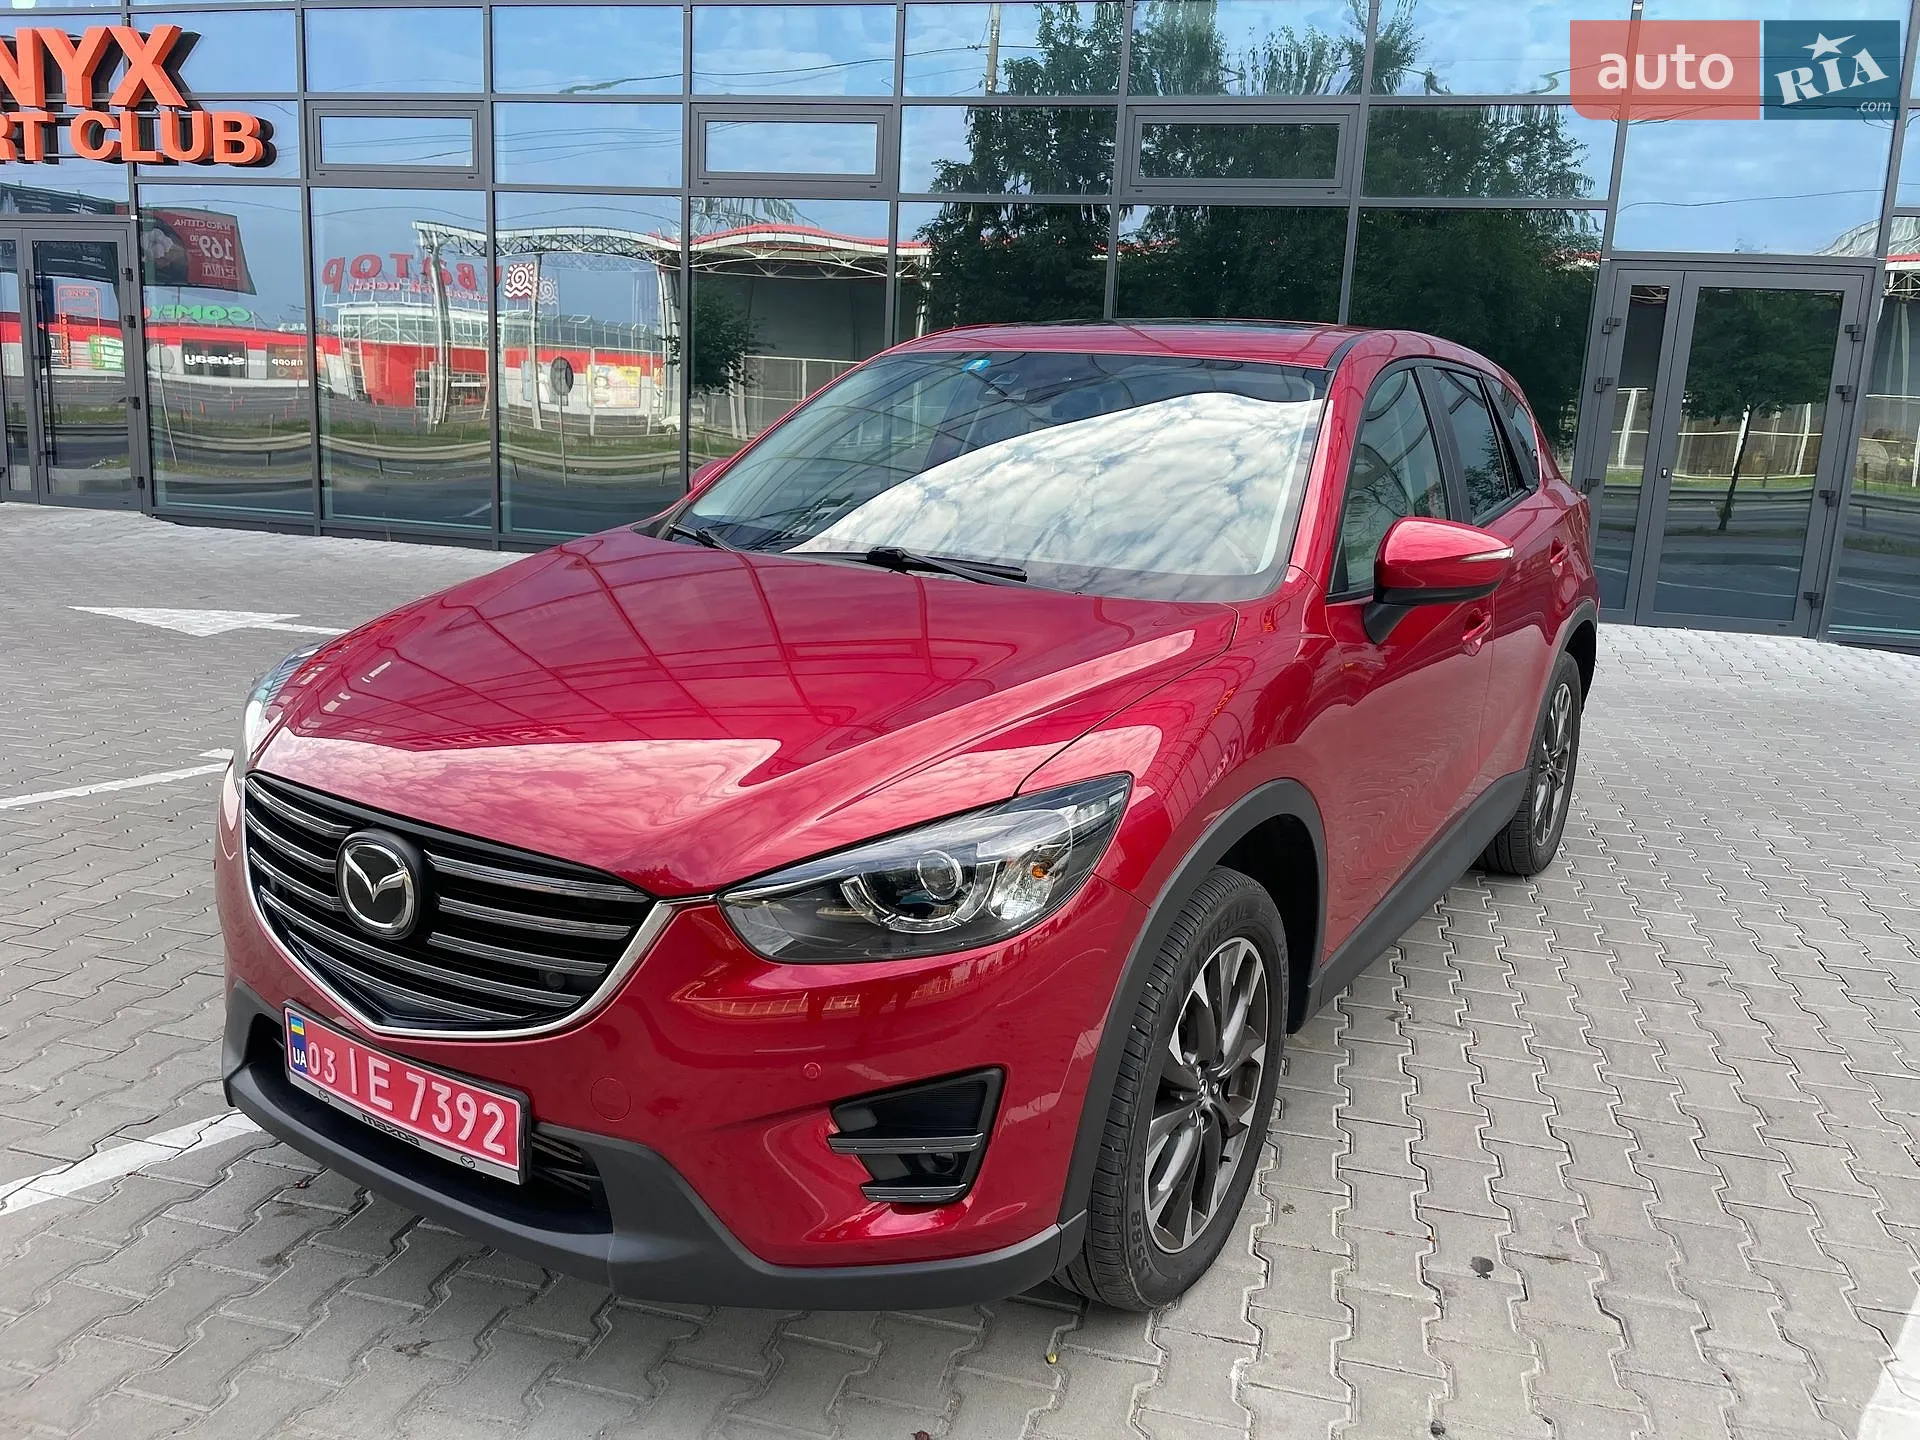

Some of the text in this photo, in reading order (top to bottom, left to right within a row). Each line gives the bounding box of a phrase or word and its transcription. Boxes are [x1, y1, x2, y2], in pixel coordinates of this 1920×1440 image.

[70, 110, 264, 164] CLUB
[293, 1046, 308, 1069] UA
[308, 1042, 337, 1084] 03
[406, 1071, 506, 1156] 7392
